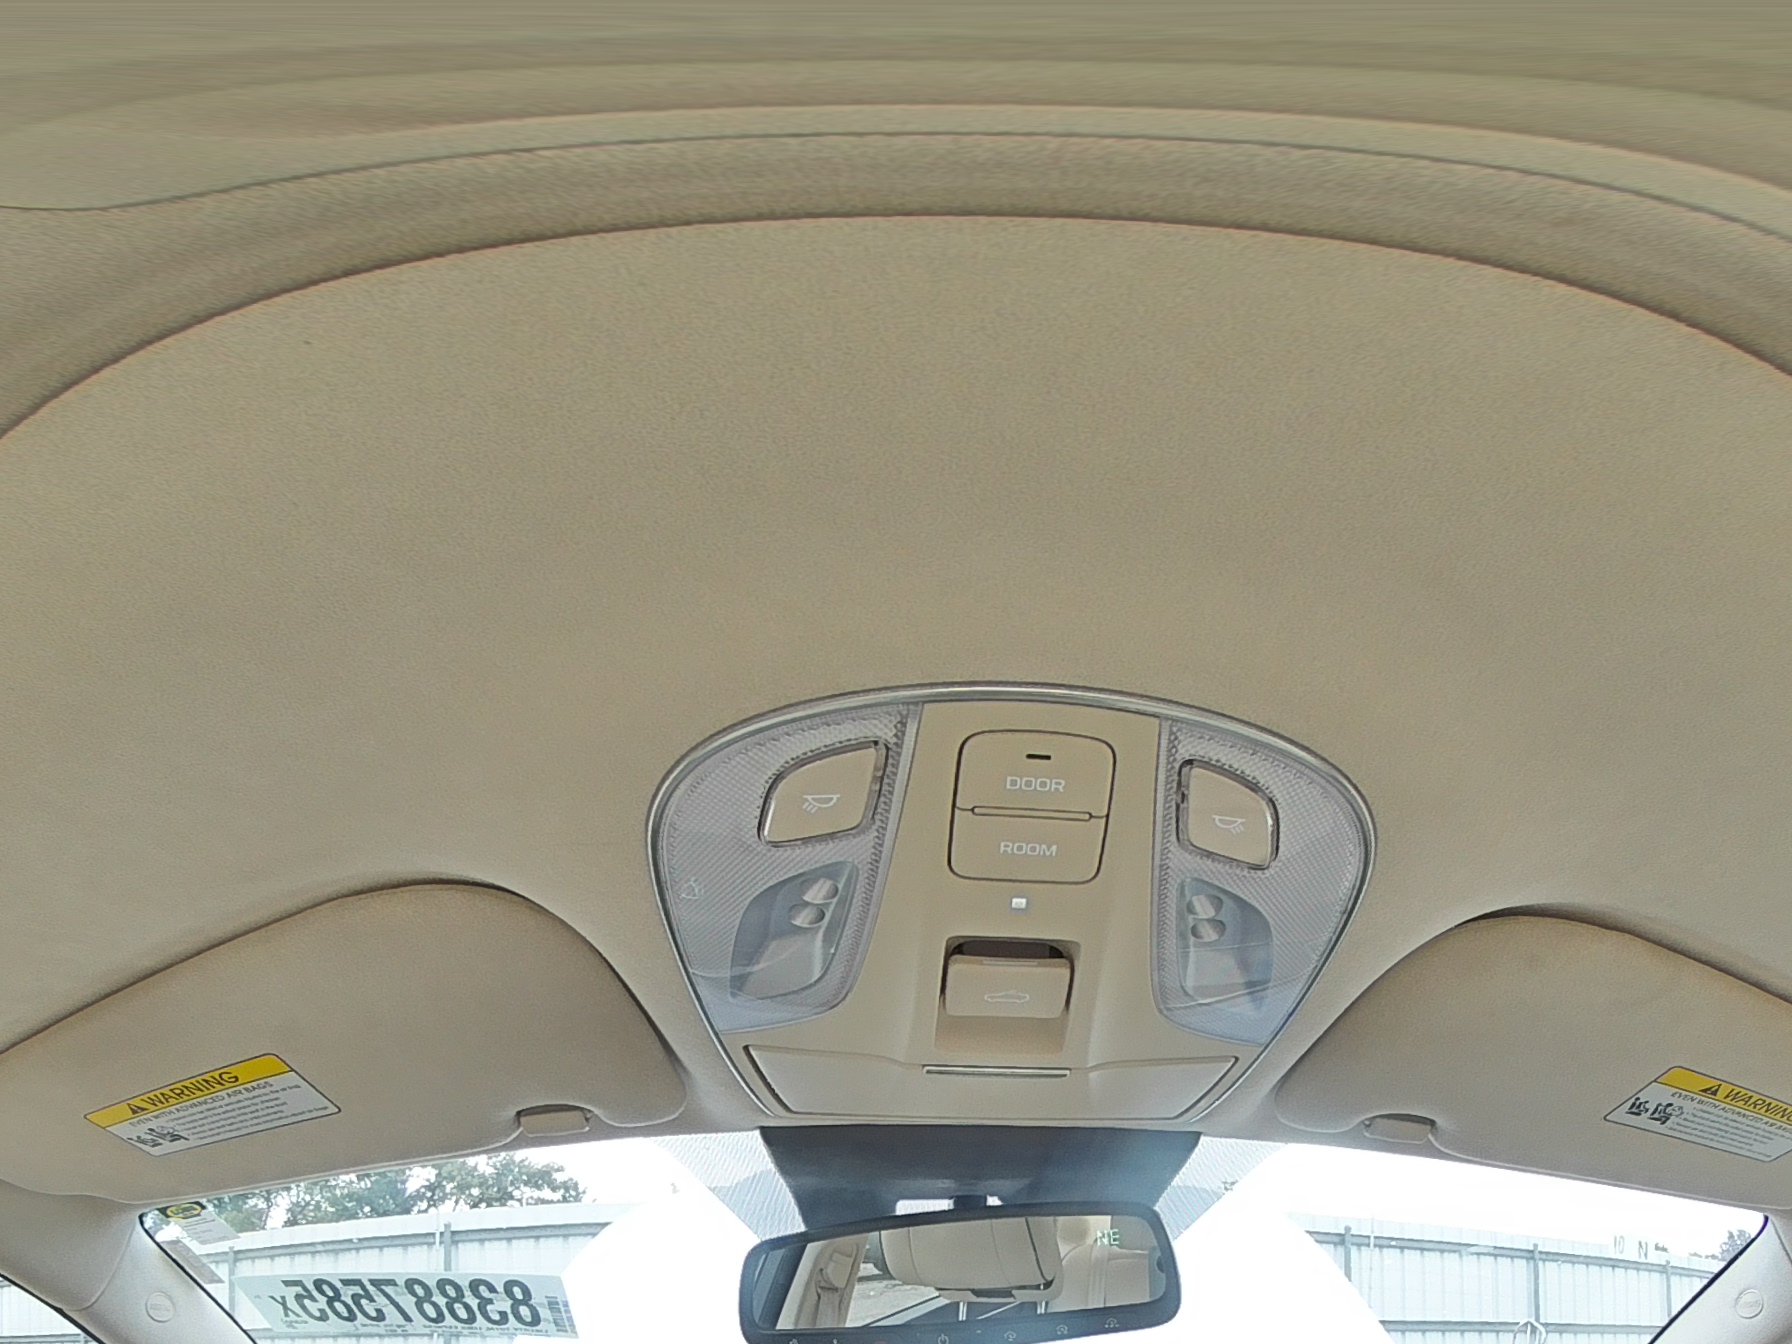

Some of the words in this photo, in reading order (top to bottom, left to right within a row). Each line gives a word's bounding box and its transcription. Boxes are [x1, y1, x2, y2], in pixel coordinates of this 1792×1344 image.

[1006, 776, 1065, 792] DOOR
[1000, 842, 1057, 856] ROOM
[141, 1071, 239, 1112] WARNING
[1669, 1090, 1697, 1102] EVEN
[127, 1117, 154, 1127] EVEN
[150, 1109, 176, 1120] WITH
[172, 1093, 226, 1113] ADVANCED
[222, 1088, 244, 1098] AIR
[241, 1079, 275, 1093] BAGS
[1097, 1229, 1119, 1246] NE
